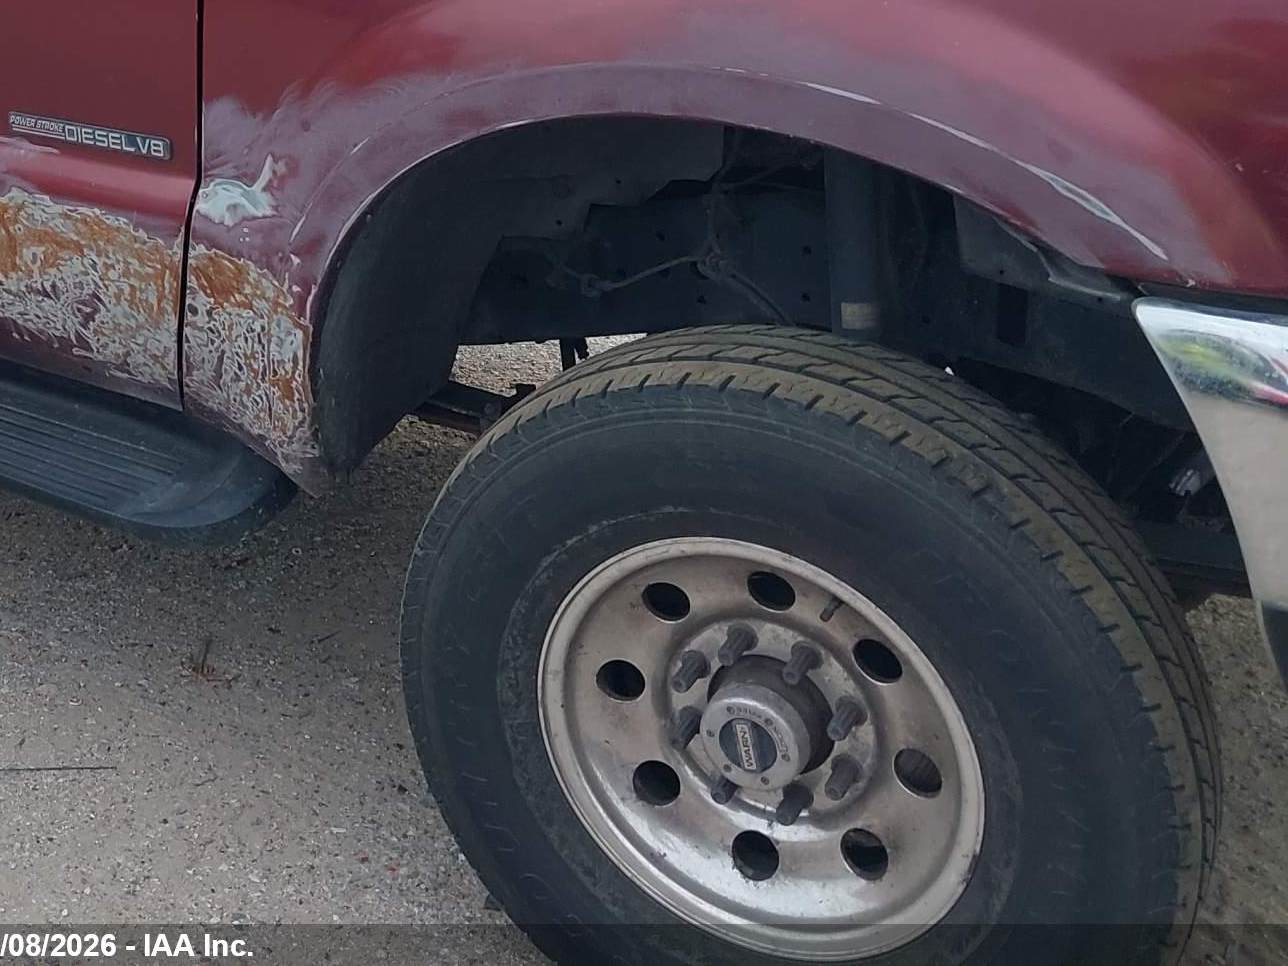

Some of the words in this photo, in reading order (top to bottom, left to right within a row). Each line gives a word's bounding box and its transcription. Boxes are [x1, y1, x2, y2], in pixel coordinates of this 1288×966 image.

[9, 115, 36, 128] POWER
[35, 119, 65, 133] STROKE
[740, 730, 754, 768] WARN
